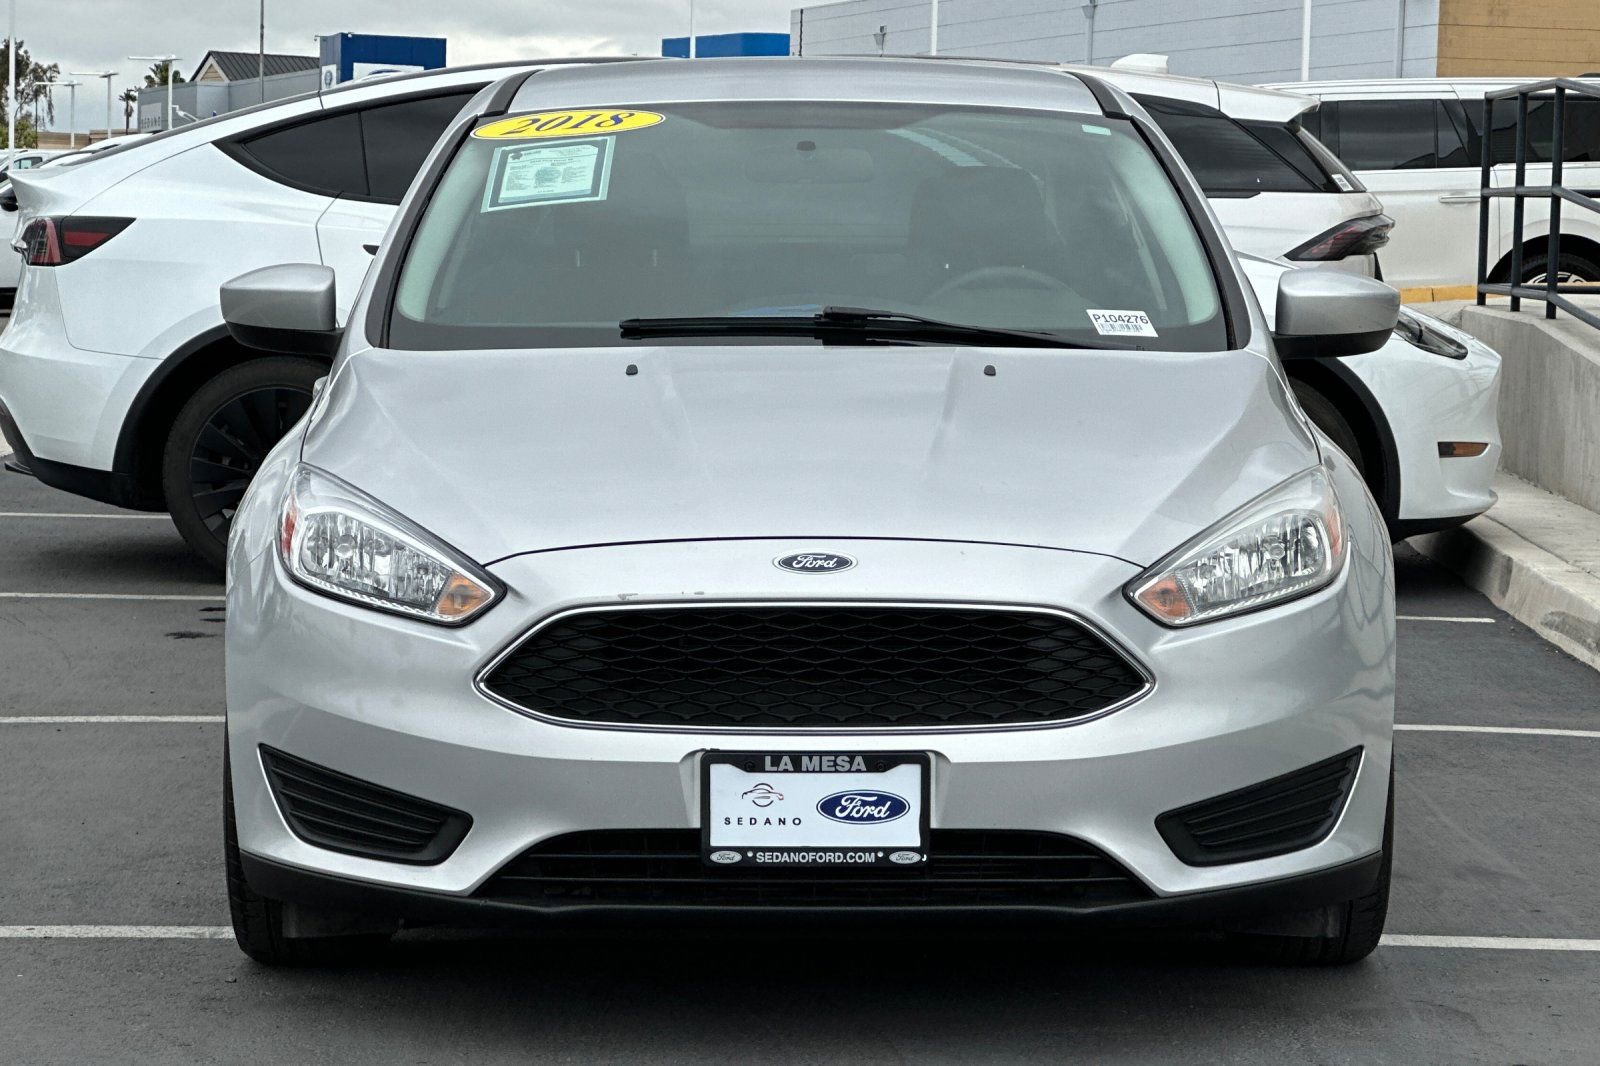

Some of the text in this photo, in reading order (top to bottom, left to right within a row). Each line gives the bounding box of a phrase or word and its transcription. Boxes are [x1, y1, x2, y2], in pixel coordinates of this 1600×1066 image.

[500, 112, 635, 136] 2018
[1092, 313, 1149, 325] P104276
[792, 554, 838, 568] Ford
[764, 756, 867, 772] LA MESA
[835, 796, 892, 818] Ford
[724, 817, 802, 826] SEDANO
[716, 853, 736, 862] Ford
[756, 852, 875, 863] SEDANOFORD.COM
[895, 853, 915, 862] Ford
